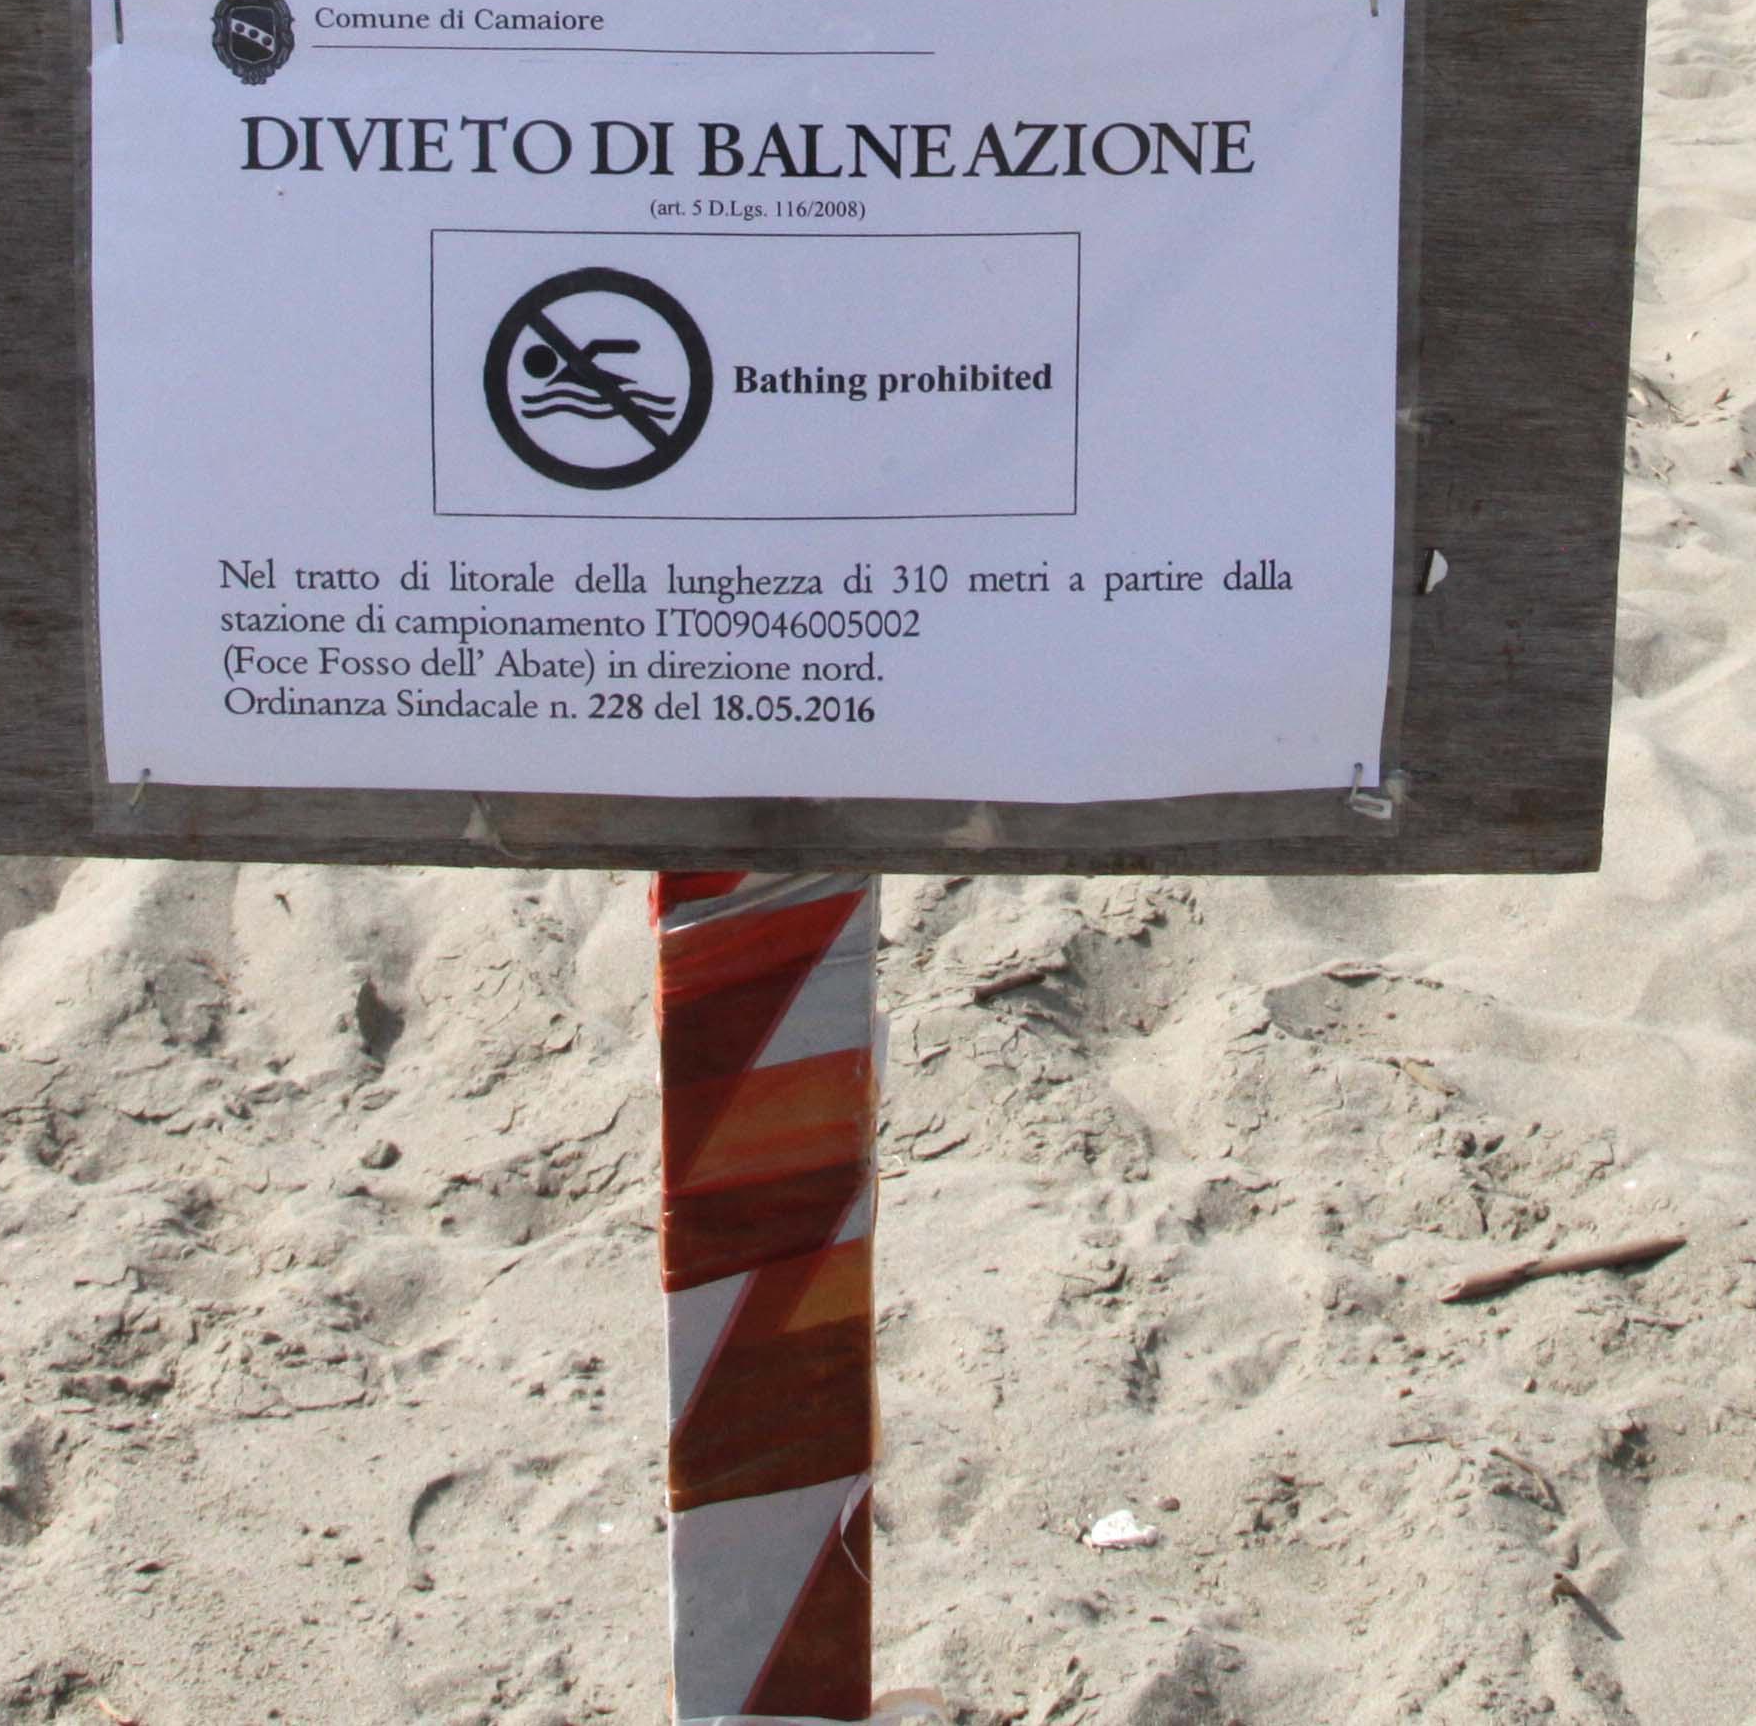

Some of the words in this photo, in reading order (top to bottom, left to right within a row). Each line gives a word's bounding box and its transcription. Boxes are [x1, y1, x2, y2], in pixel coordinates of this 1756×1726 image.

[315, 7, 430, 29] Comune
[440, 8, 464, 30] di
[475, 9, 604, 30] Camaiore
[240, 115, 572, 175] DIVIETO
[590, 121, 674, 176] DI
[698, 120, 1255, 180] BALNEAZIONE
[650, 199, 685, 219] (art.
[692, 199, 702, 216] 5
[708, 200, 767, 221] D.Lgs.
[777, 201, 865, 221] 116/2008)
[733, 366, 868, 401] Bathing
[878, 363, 1053, 402] prohibited
[218, 558, 276, 589] Nel
[295, 568, 380, 590] tratto
[400, 560, 430, 591] di
[449, 560, 554, 593] litorale
[575, 562, 648, 594] della
[668, 563, 823, 603] lunghezza
[843, 562, 873, 594] di
[892, 564, 948, 594] 310
[968, 561, 1050, 592] metri
[1069, 572, 1085, 592] a
[1104, 561, 1203, 602] partire
[1223, 559, 1293, 591] dalla
[221, 604, 345, 633] stazione
[356, 603, 386, 633] di
[395, 605, 645, 642] campionamento
[656, 608, 920, 638] IT009046005002
[224, 644, 308, 682] (Foce
[318, 647, 411, 676] Fosso
[495, 648, 595, 686] Abate)
[608, 650, 638, 678] in
[647, 650, 790, 680] direzione
[802, 651, 883, 681] nord.
[224, 686, 387, 716] Ordinanza
[397, 688, 538, 718] Sindacale
[549, 701, 577, 719] n.
[588, 693, 643, 720] 228
[654, 690, 701, 720] del
[713, 694, 875, 723] 18.05.2016
